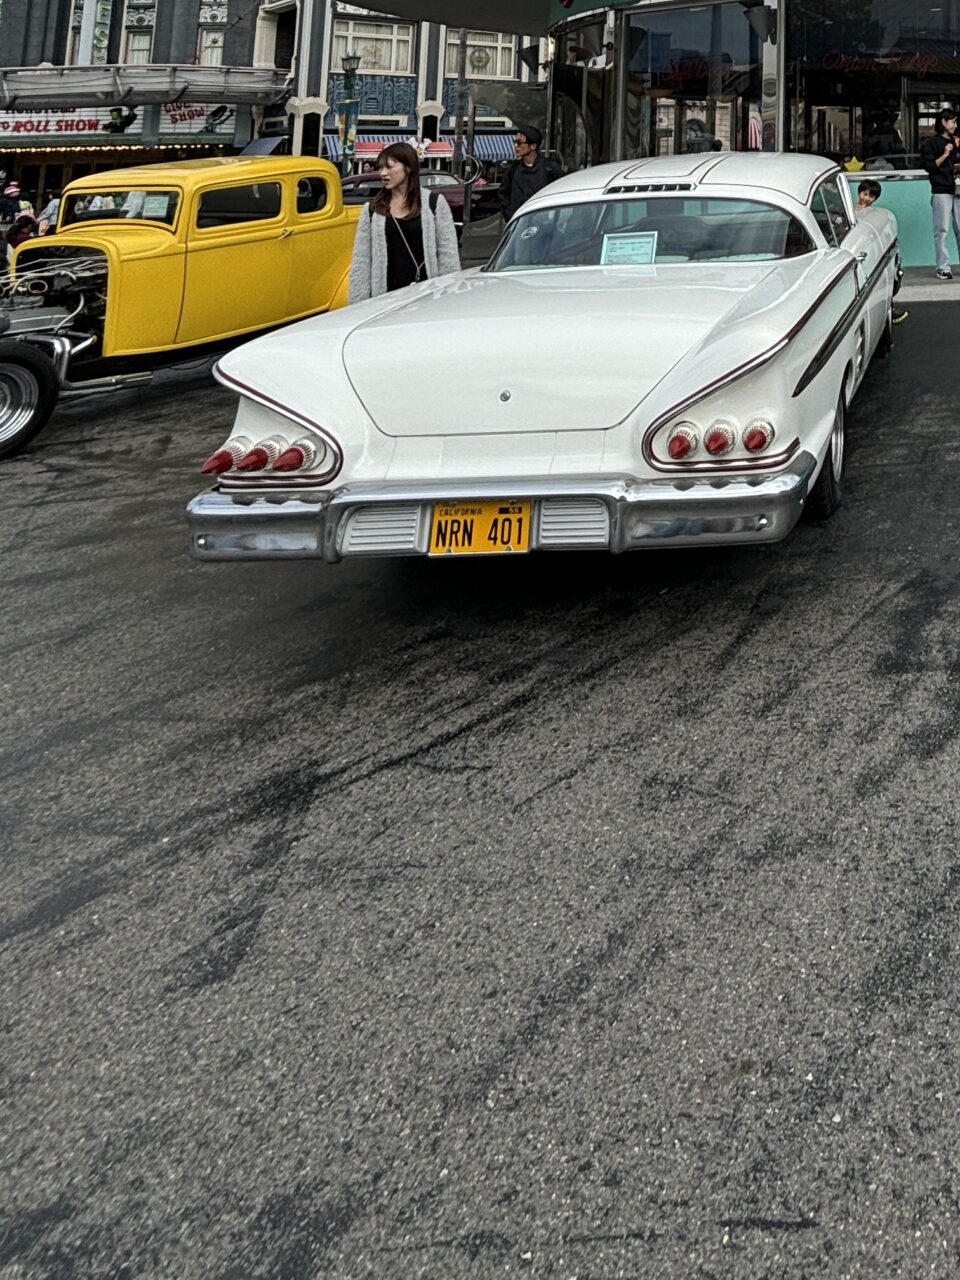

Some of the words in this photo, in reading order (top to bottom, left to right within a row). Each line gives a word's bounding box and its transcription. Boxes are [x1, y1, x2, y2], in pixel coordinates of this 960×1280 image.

[822, 47, 876, 71] Onion
[170, 106, 205, 124] SHOW
[12, 120, 50, 133] ROLL
[54, 118, 100, 132] SHOW
[439, 507, 482, 517] CALIFORNIA
[435, 518, 474, 548] NRN
[487, 517, 523, 546] 401
